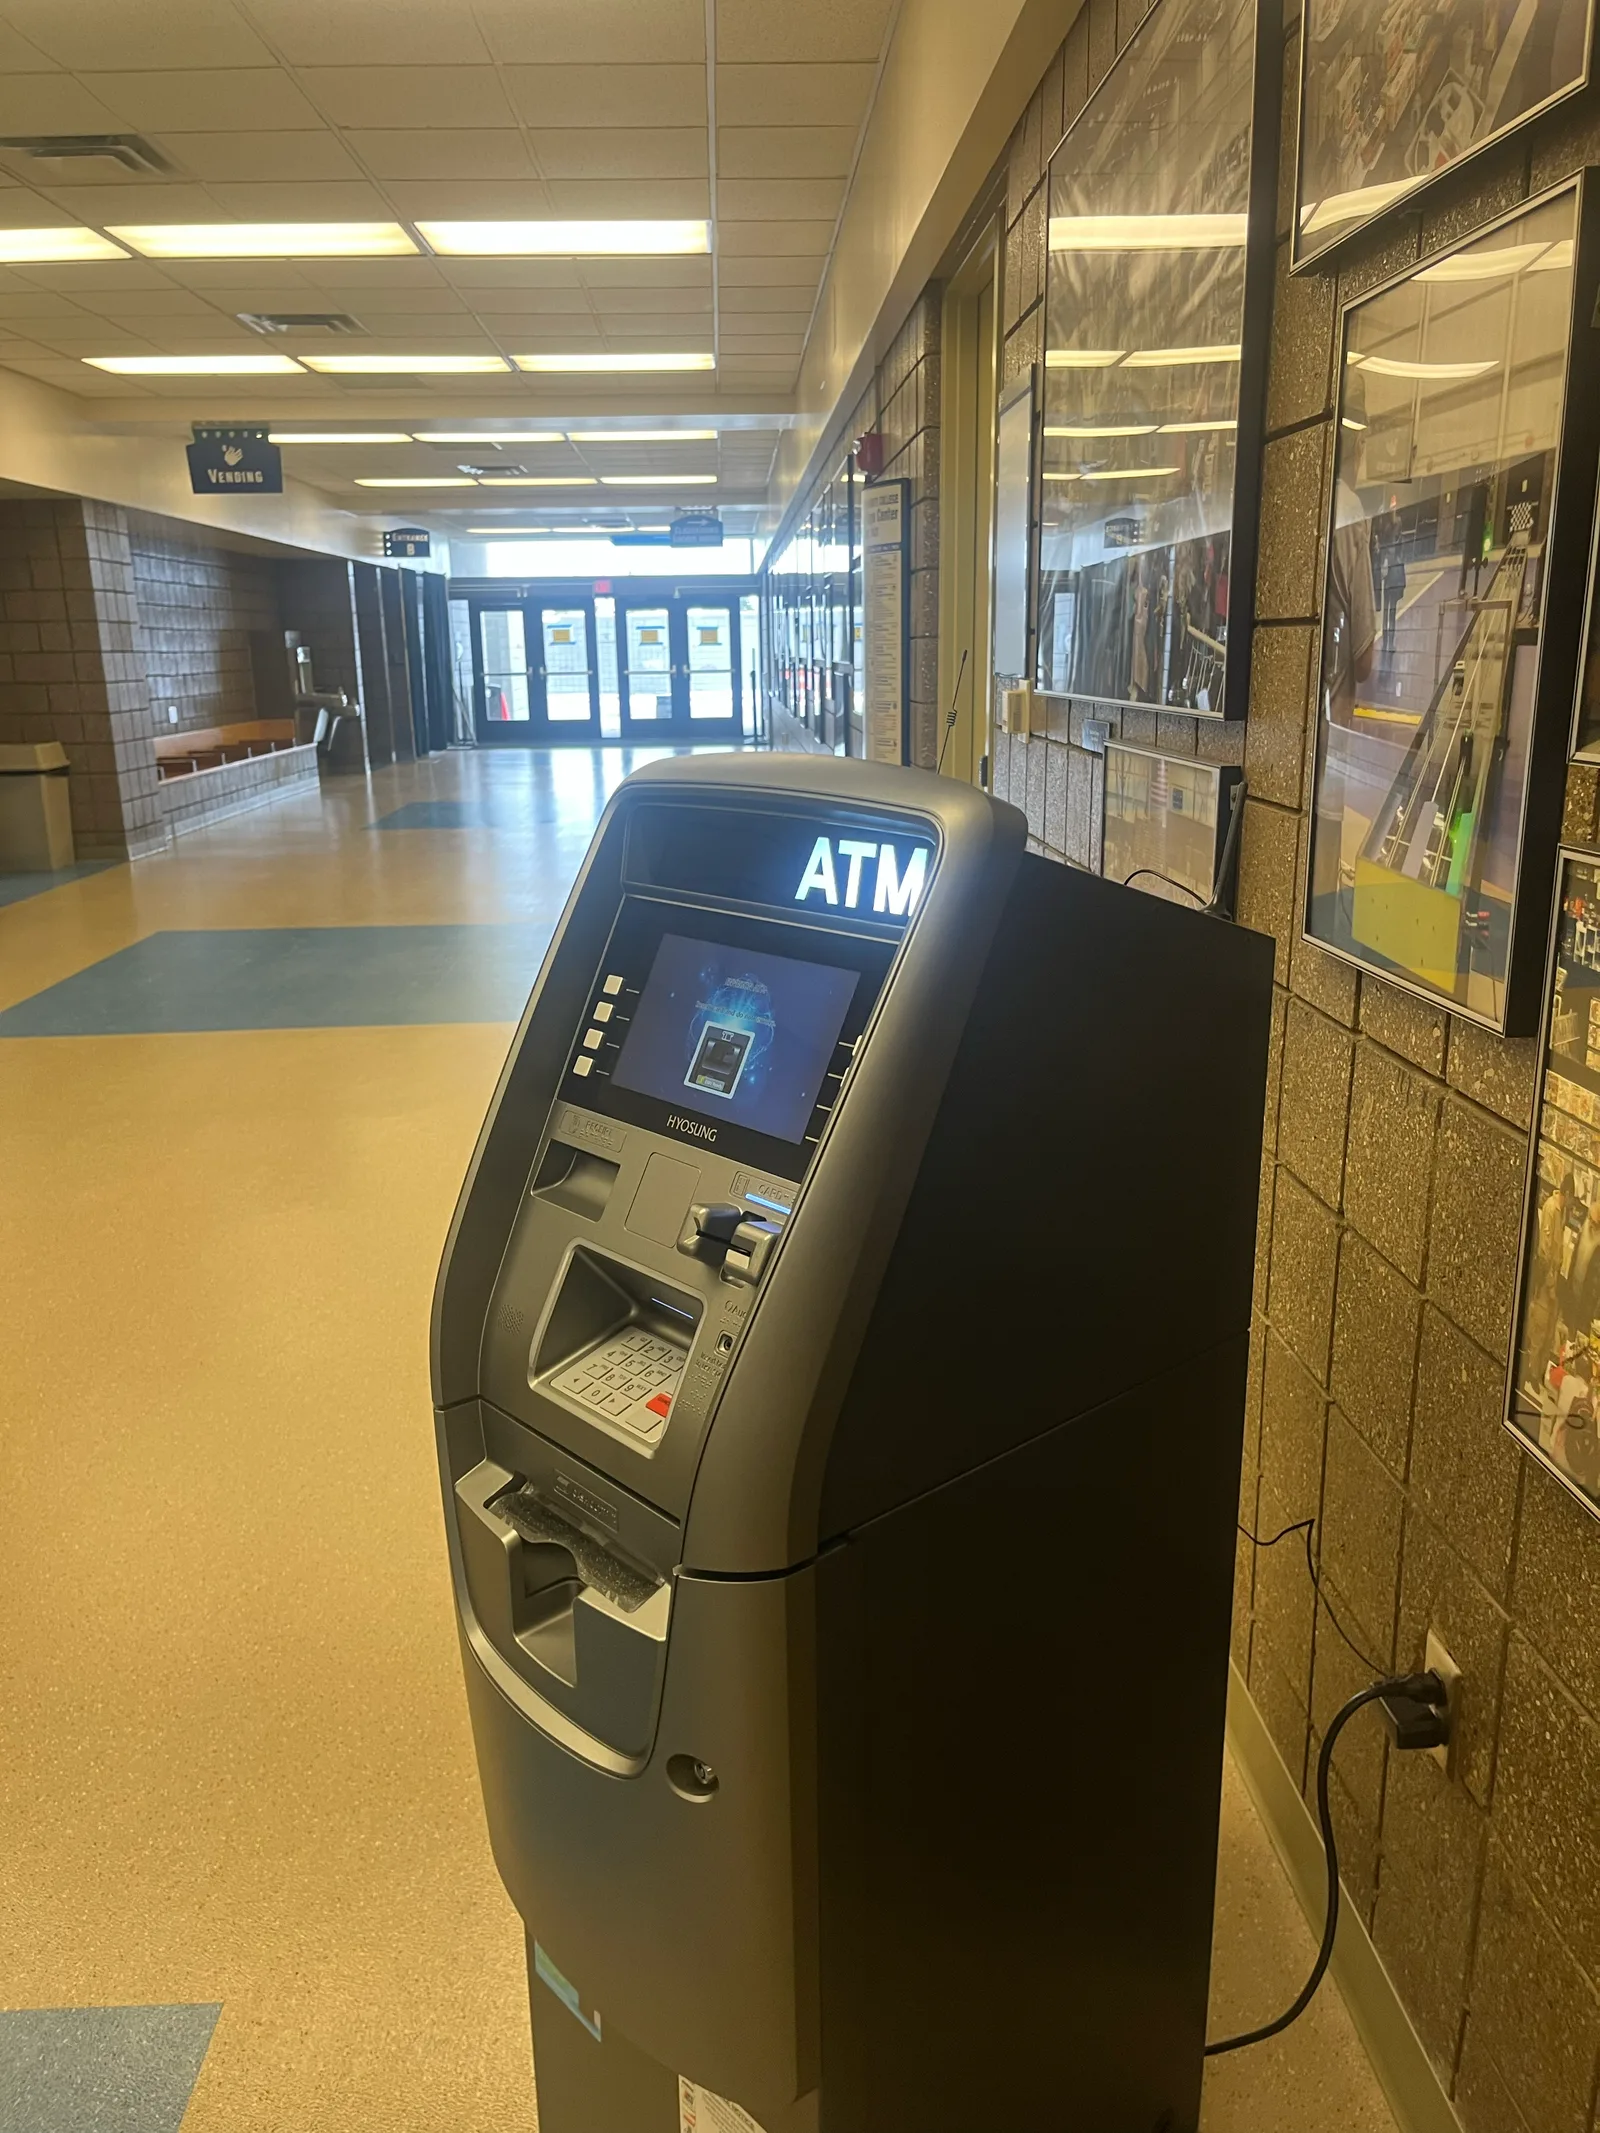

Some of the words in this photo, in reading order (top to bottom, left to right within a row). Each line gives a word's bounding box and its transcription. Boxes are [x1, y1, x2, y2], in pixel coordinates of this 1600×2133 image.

[207, 468, 264, 484] VENDING
[795, 836, 928, 917] ATM
[666, 1114, 718, 1143] HYOSUNG
[758, 1183, 783, 1201] CARD
[626, 1336, 635, 1344] 1
[607, 1350, 616, 1358] 4
[644, 1345, 654, 1354] 2
[625, 1359, 635, 1367] 5
[663, 1355, 673, 1364] 3
[587, 1363, 598, 1371] 7
[605, 1373, 616, 1382] 8
[644, 1369, 655, 1378] 6
[624, 1383, 635, 1392] 9
[591, 1389, 601, 1397] 0
